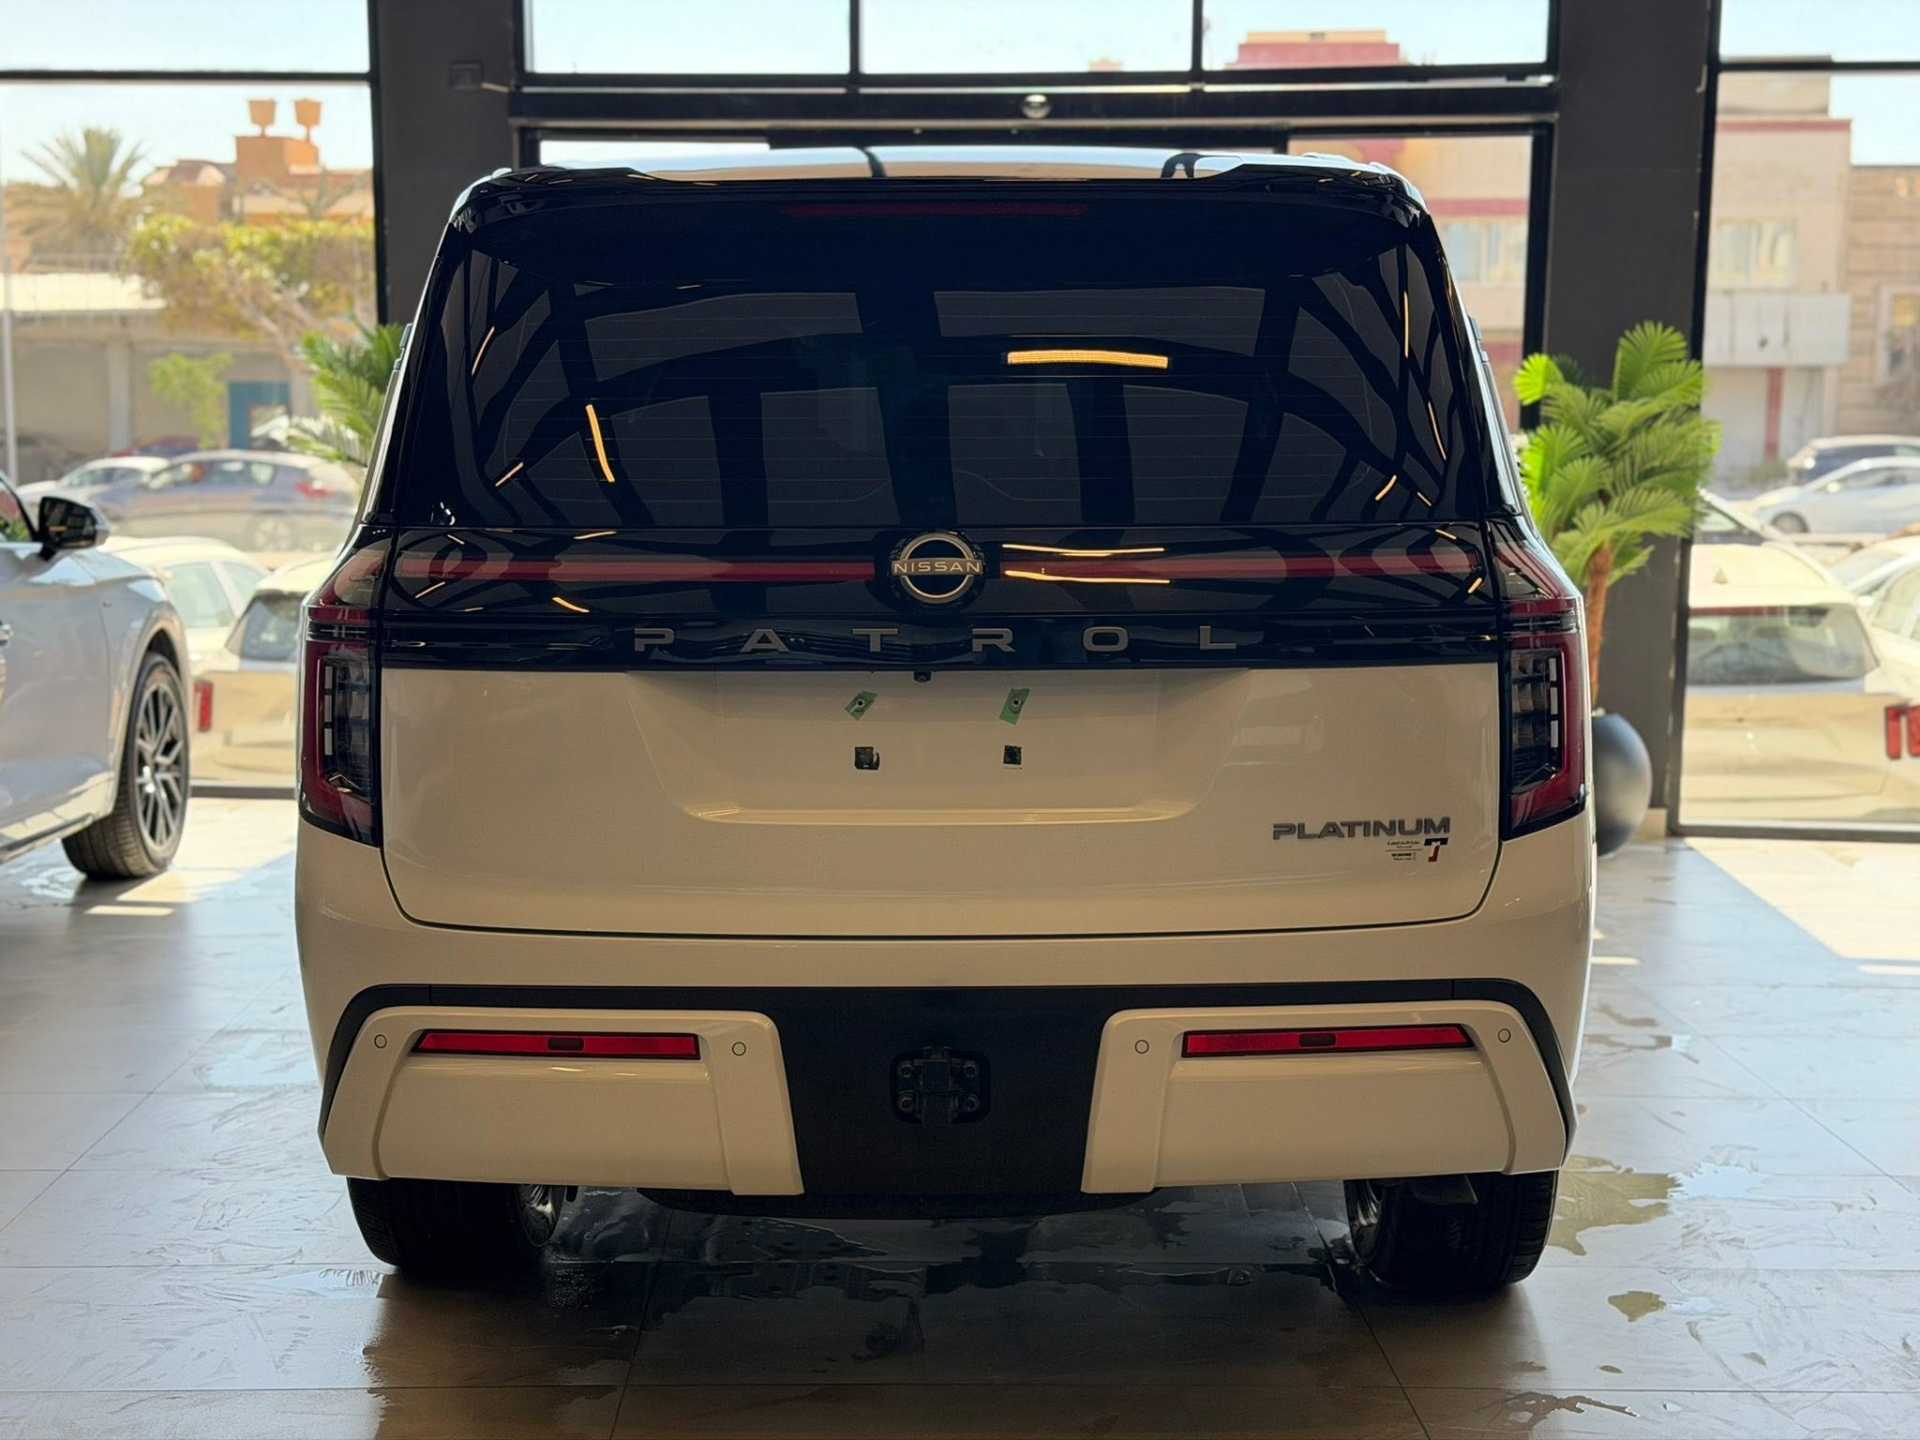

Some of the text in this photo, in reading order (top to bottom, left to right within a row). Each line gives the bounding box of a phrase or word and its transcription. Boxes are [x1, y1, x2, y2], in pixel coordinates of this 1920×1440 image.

[893, 560, 981, 574] NISSAN
[634, 625, 1238, 653] PATROL
[1272, 816, 1451, 841] PLATINUM
